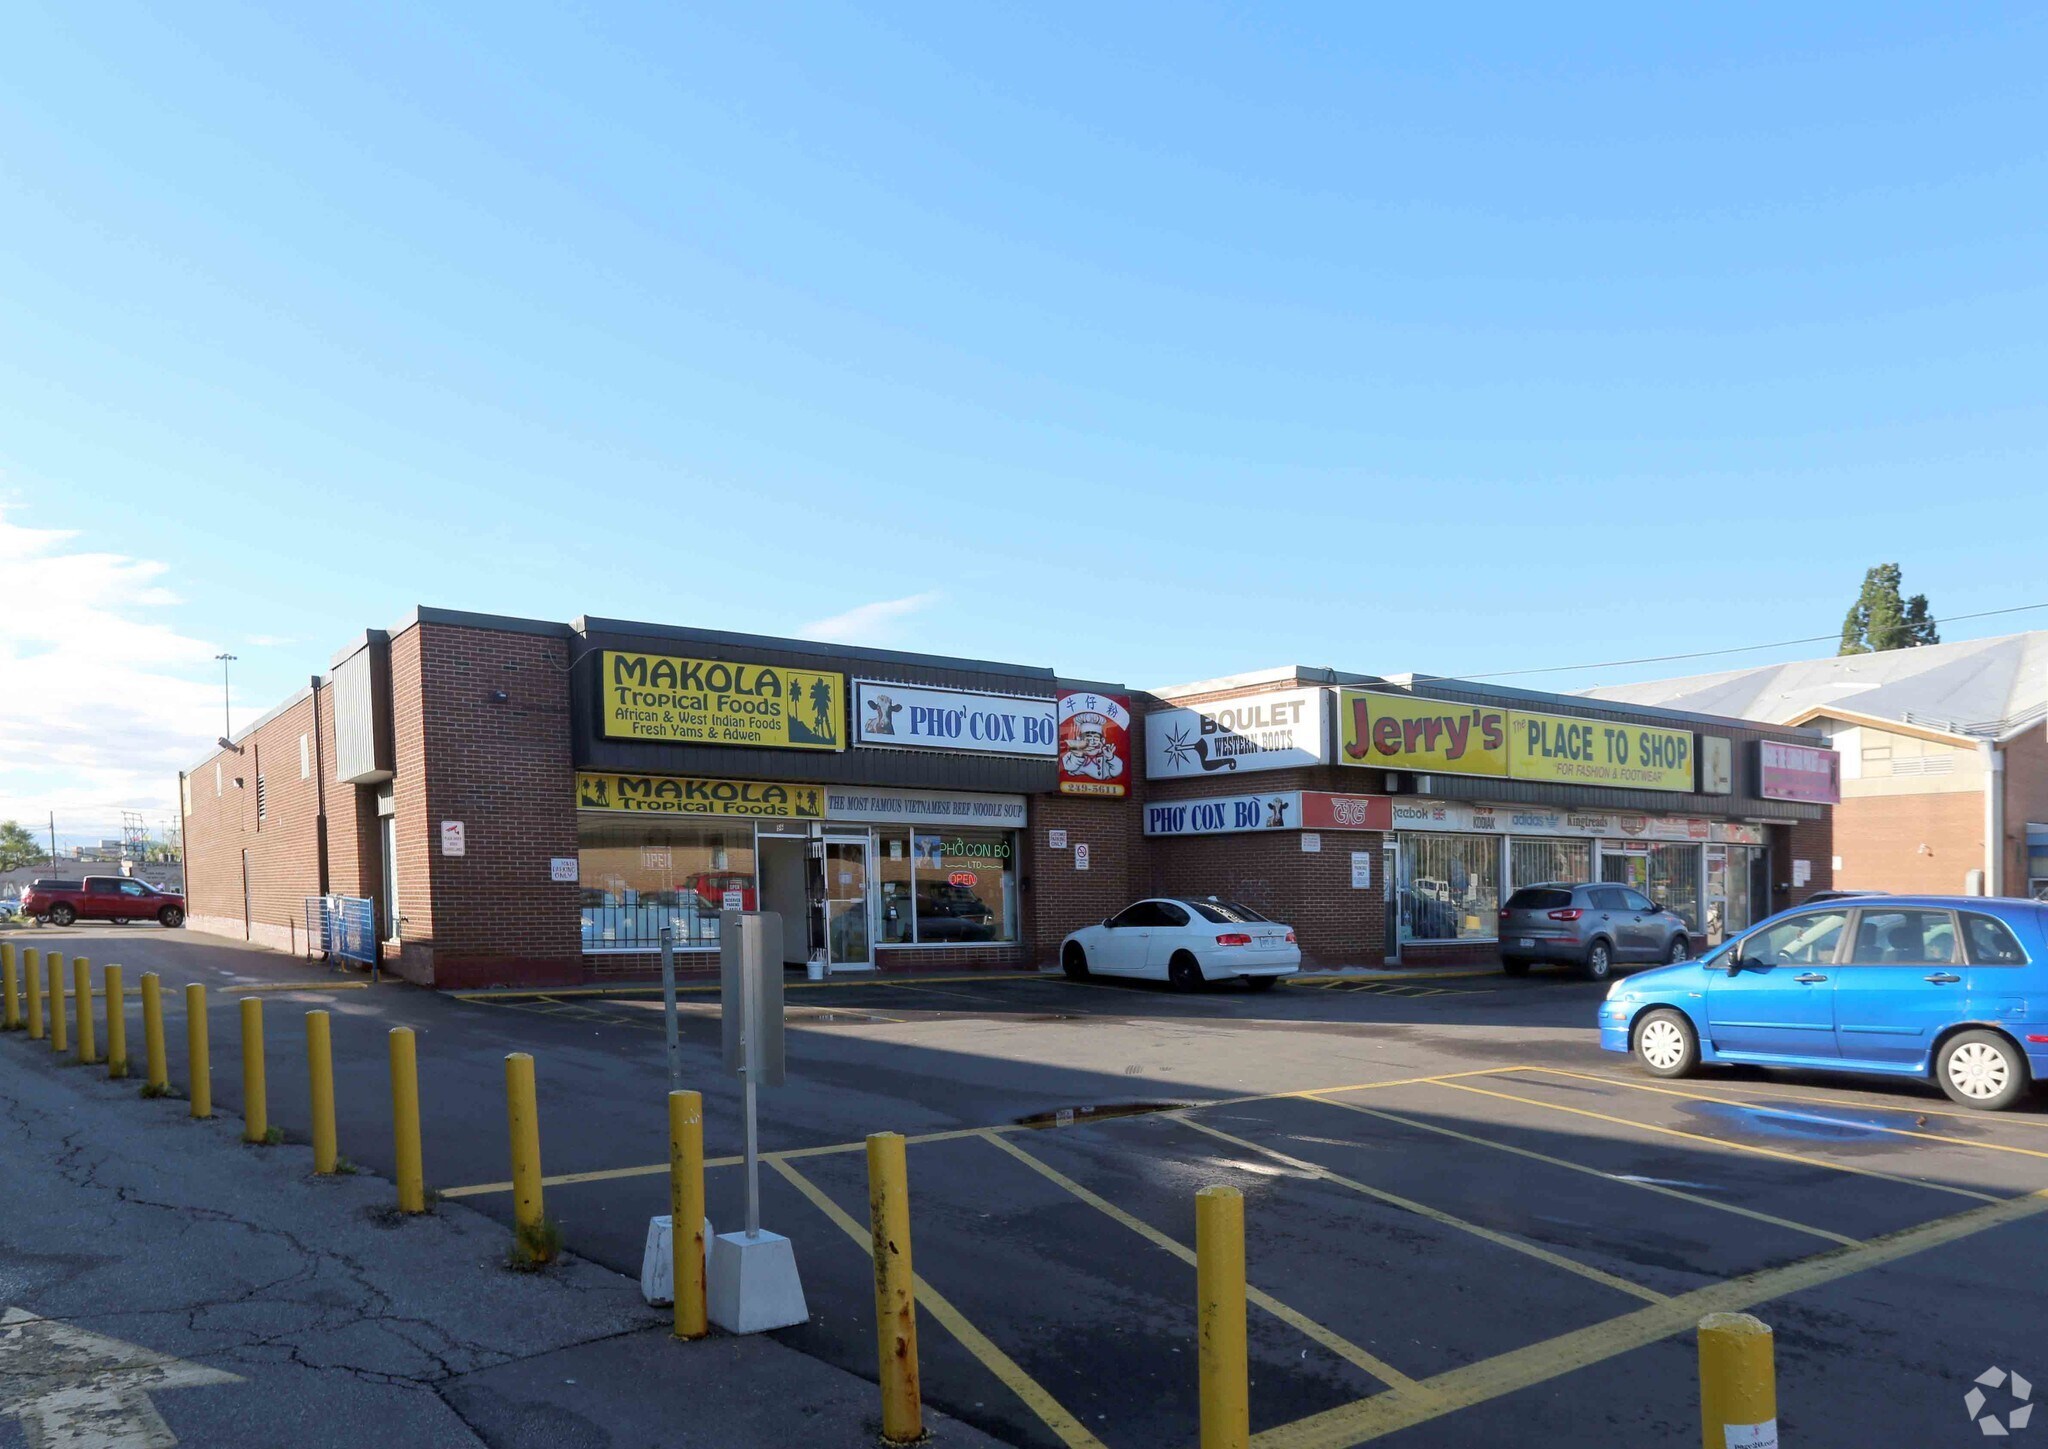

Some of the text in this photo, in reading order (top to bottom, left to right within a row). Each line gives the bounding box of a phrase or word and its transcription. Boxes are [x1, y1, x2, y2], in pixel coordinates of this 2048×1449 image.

[614, 655, 782, 697] MAKOLA
[614, 687, 781, 716] Tropical Foods
[1066, 695, 1118, 718] 牛仔粉
[615, 708, 781, 730] African & West Indian Foods
[970, 711, 1016, 743] CON
[1022, 712, 1055, 745] BÒ
[1201, 700, 1305, 735] BOULET
[633, 721, 761, 742] Fresh Yams & Adwen
[1344, 698, 1504, 761] Jerry's
[1214, 730, 1293, 757] WESTERN BOOTS
[1513, 719, 1687, 769] The PLACE TO SHOP
[1576, 765, 1611, 778] FASHION
[617, 777, 788, 804] MAKOLA
[1068, 784, 1117, 794] 249-5611
[617, 797, 788, 816] Tropical Foods
[829, 795, 1023, 818] THE MOST FAMOUS VIETNAMESE BEEF NOODLE SOUP
[1192, 803, 1226, 830] CON
[1234, 797, 1260, 828] BÒ
[1473, 816, 1495, 829] KODIAK
[1513, 812, 1544, 826] adidas
[1567, 814, 1608, 830] Kingtreads
[940, 838, 1010, 858] PHỞ CON BÒ
[968, 861, 982, 869] LTD
[951, 874, 976, 885] OPEN
